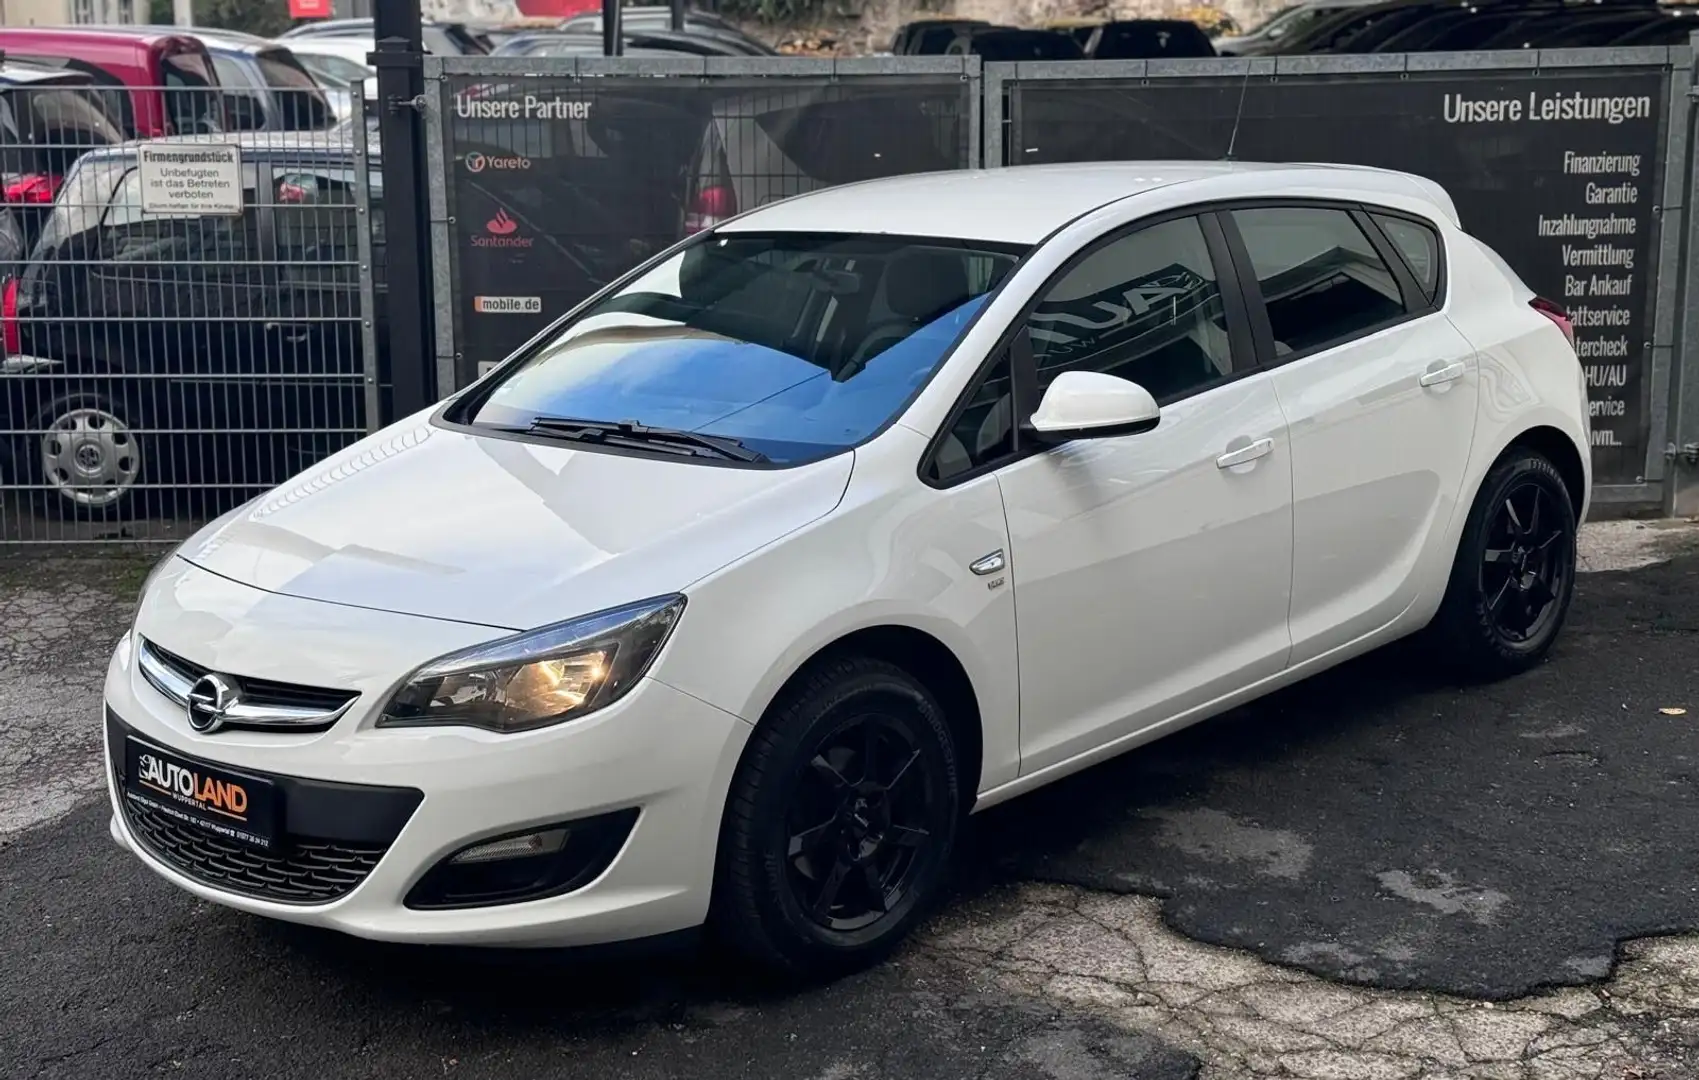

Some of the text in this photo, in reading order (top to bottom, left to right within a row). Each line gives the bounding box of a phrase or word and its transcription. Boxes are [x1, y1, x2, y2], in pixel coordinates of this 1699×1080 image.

[457, 95, 592, 119] Unsere Partner
[1444, 92, 1650, 124] Unsere Leistungen
[144, 150, 234, 164] Firmengrundstück
[487, 156, 531, 169] Yareto
[1564, 151, 1641, 176] Finanzierung
[150, 179, 230, 188] ist das Betreten
[160, 168, 219, 179] Unbefugten
[168, 191, 213, 199] verboten
[1586, 182, 1638, 204] Garantie
[1538, 213, 1636, 239] Inzahlungnahme
[470, 235, 534, 247] Santander
[1562, 244, 1634, 268] Vermittlung
[1565, 275, 1632, 296] Bar Ankauf
[482, 299, 539, 310] mobile.de
[1584, 365, 1627, 386] HU/AU
[147, 757, 247, 813] AUTOLAND
[172, 792, 207, 810] WUPPERTAL
